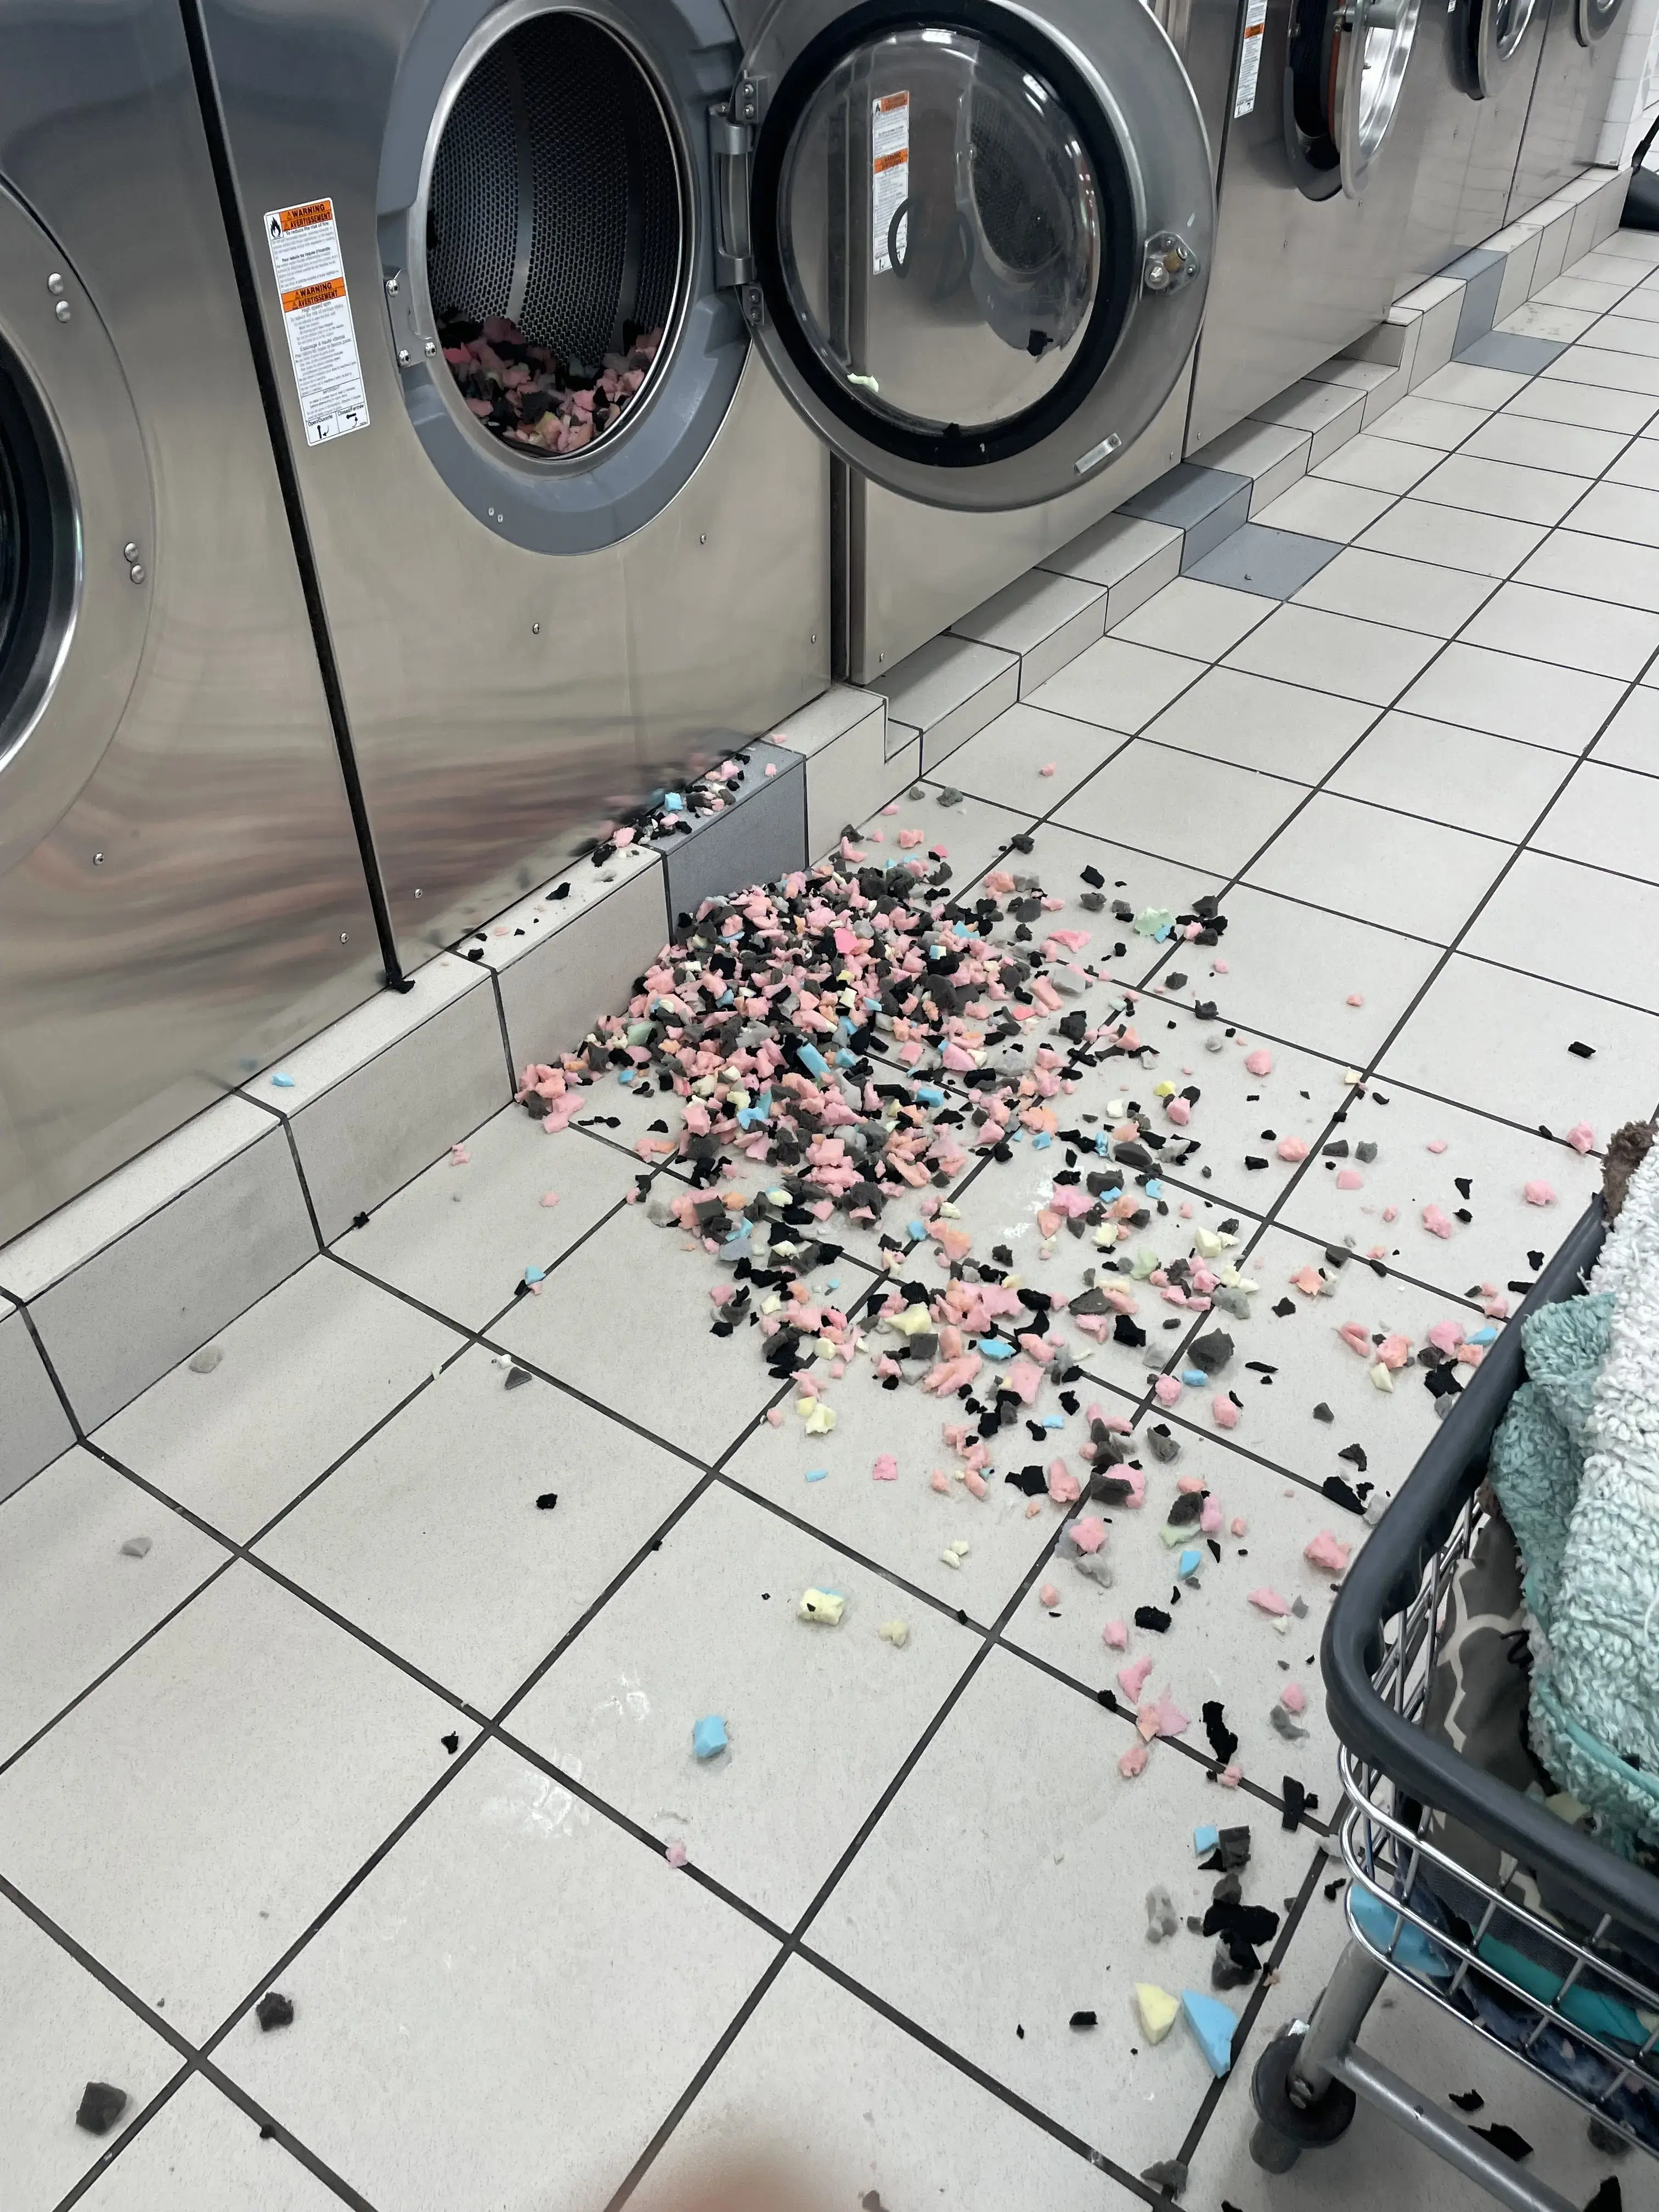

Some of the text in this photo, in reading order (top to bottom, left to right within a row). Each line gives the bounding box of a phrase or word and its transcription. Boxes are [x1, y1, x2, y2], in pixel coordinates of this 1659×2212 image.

[292, 204, 325, 217] WARNING
[290, 212, 330, 228] AVERTISSEMENT
[300, 282, 331, 296] WARNING
[298, 290, 337, 307] AVERTISSEMENT
